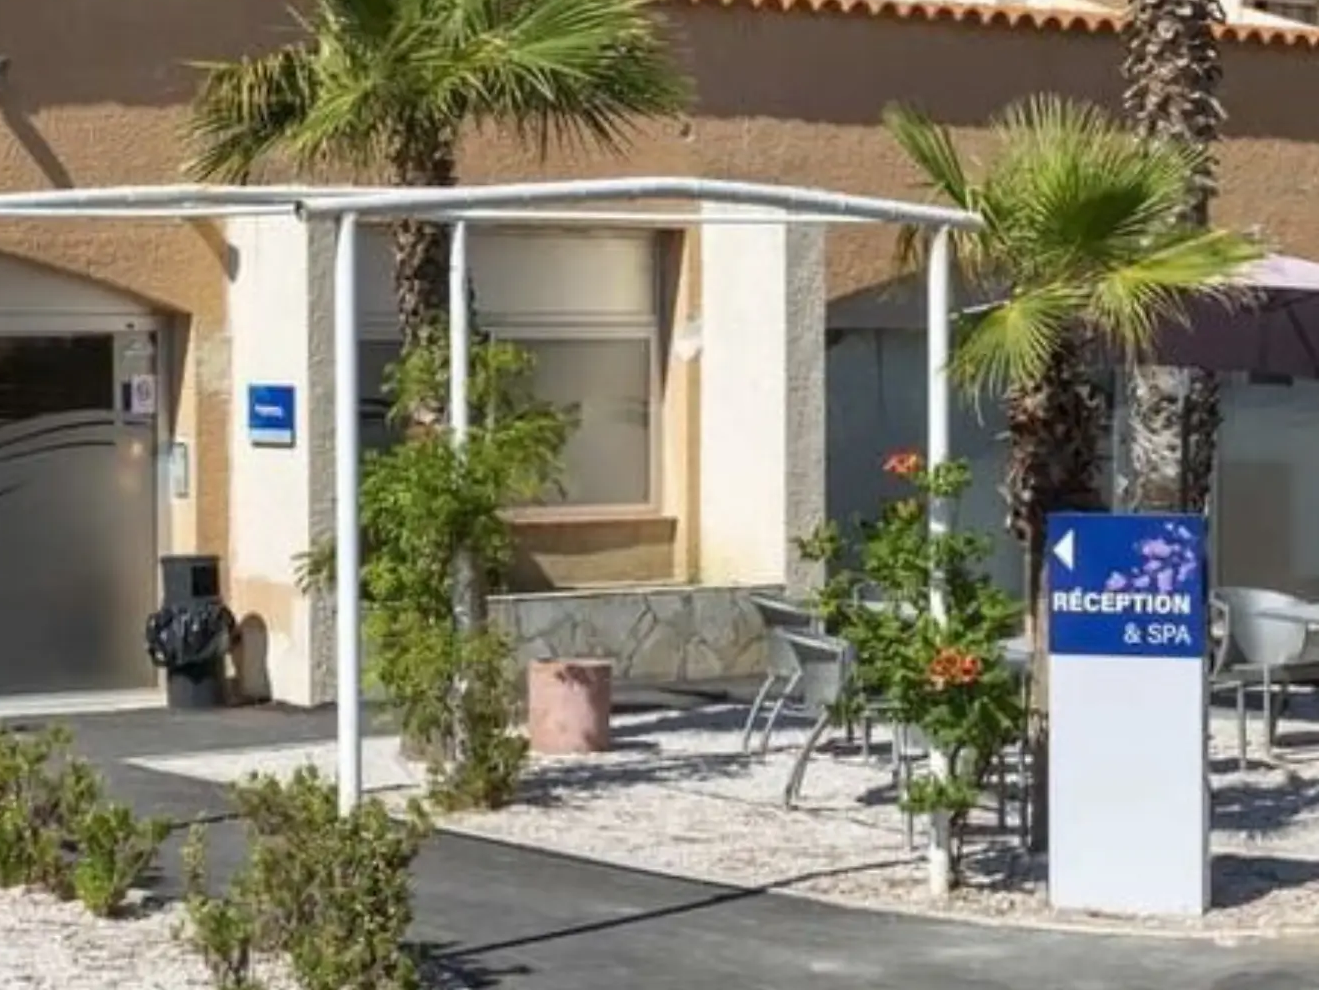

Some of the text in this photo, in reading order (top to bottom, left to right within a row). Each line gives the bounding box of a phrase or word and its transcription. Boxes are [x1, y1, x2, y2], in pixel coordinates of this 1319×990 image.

[1052, 586, 1191, 615] RÉCEPTION
[1123, 622, 1192, 646] & SPA
